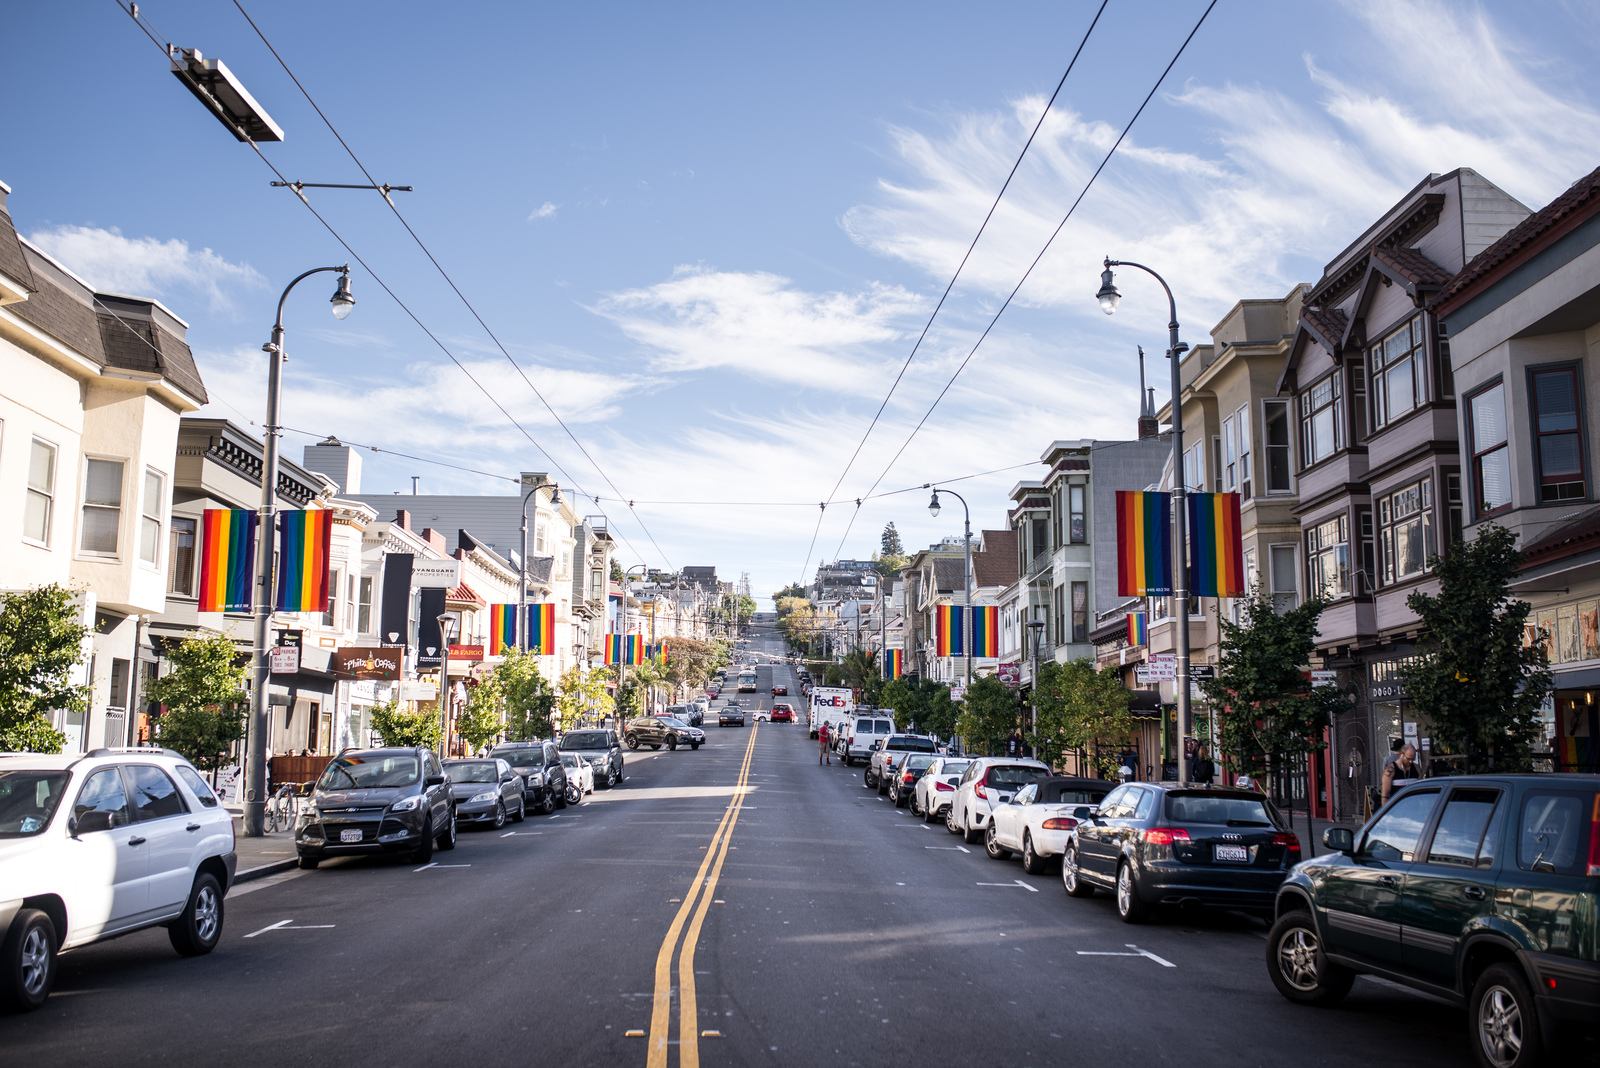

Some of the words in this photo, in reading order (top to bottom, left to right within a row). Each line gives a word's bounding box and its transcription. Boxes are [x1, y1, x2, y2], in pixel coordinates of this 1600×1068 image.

[347, 659, 367, 670] Philz
[374, 658, 396, 671] Coffee
[1373, 688, 1392, 697] DOGO
[814, 695, 846, 707] FedEx
